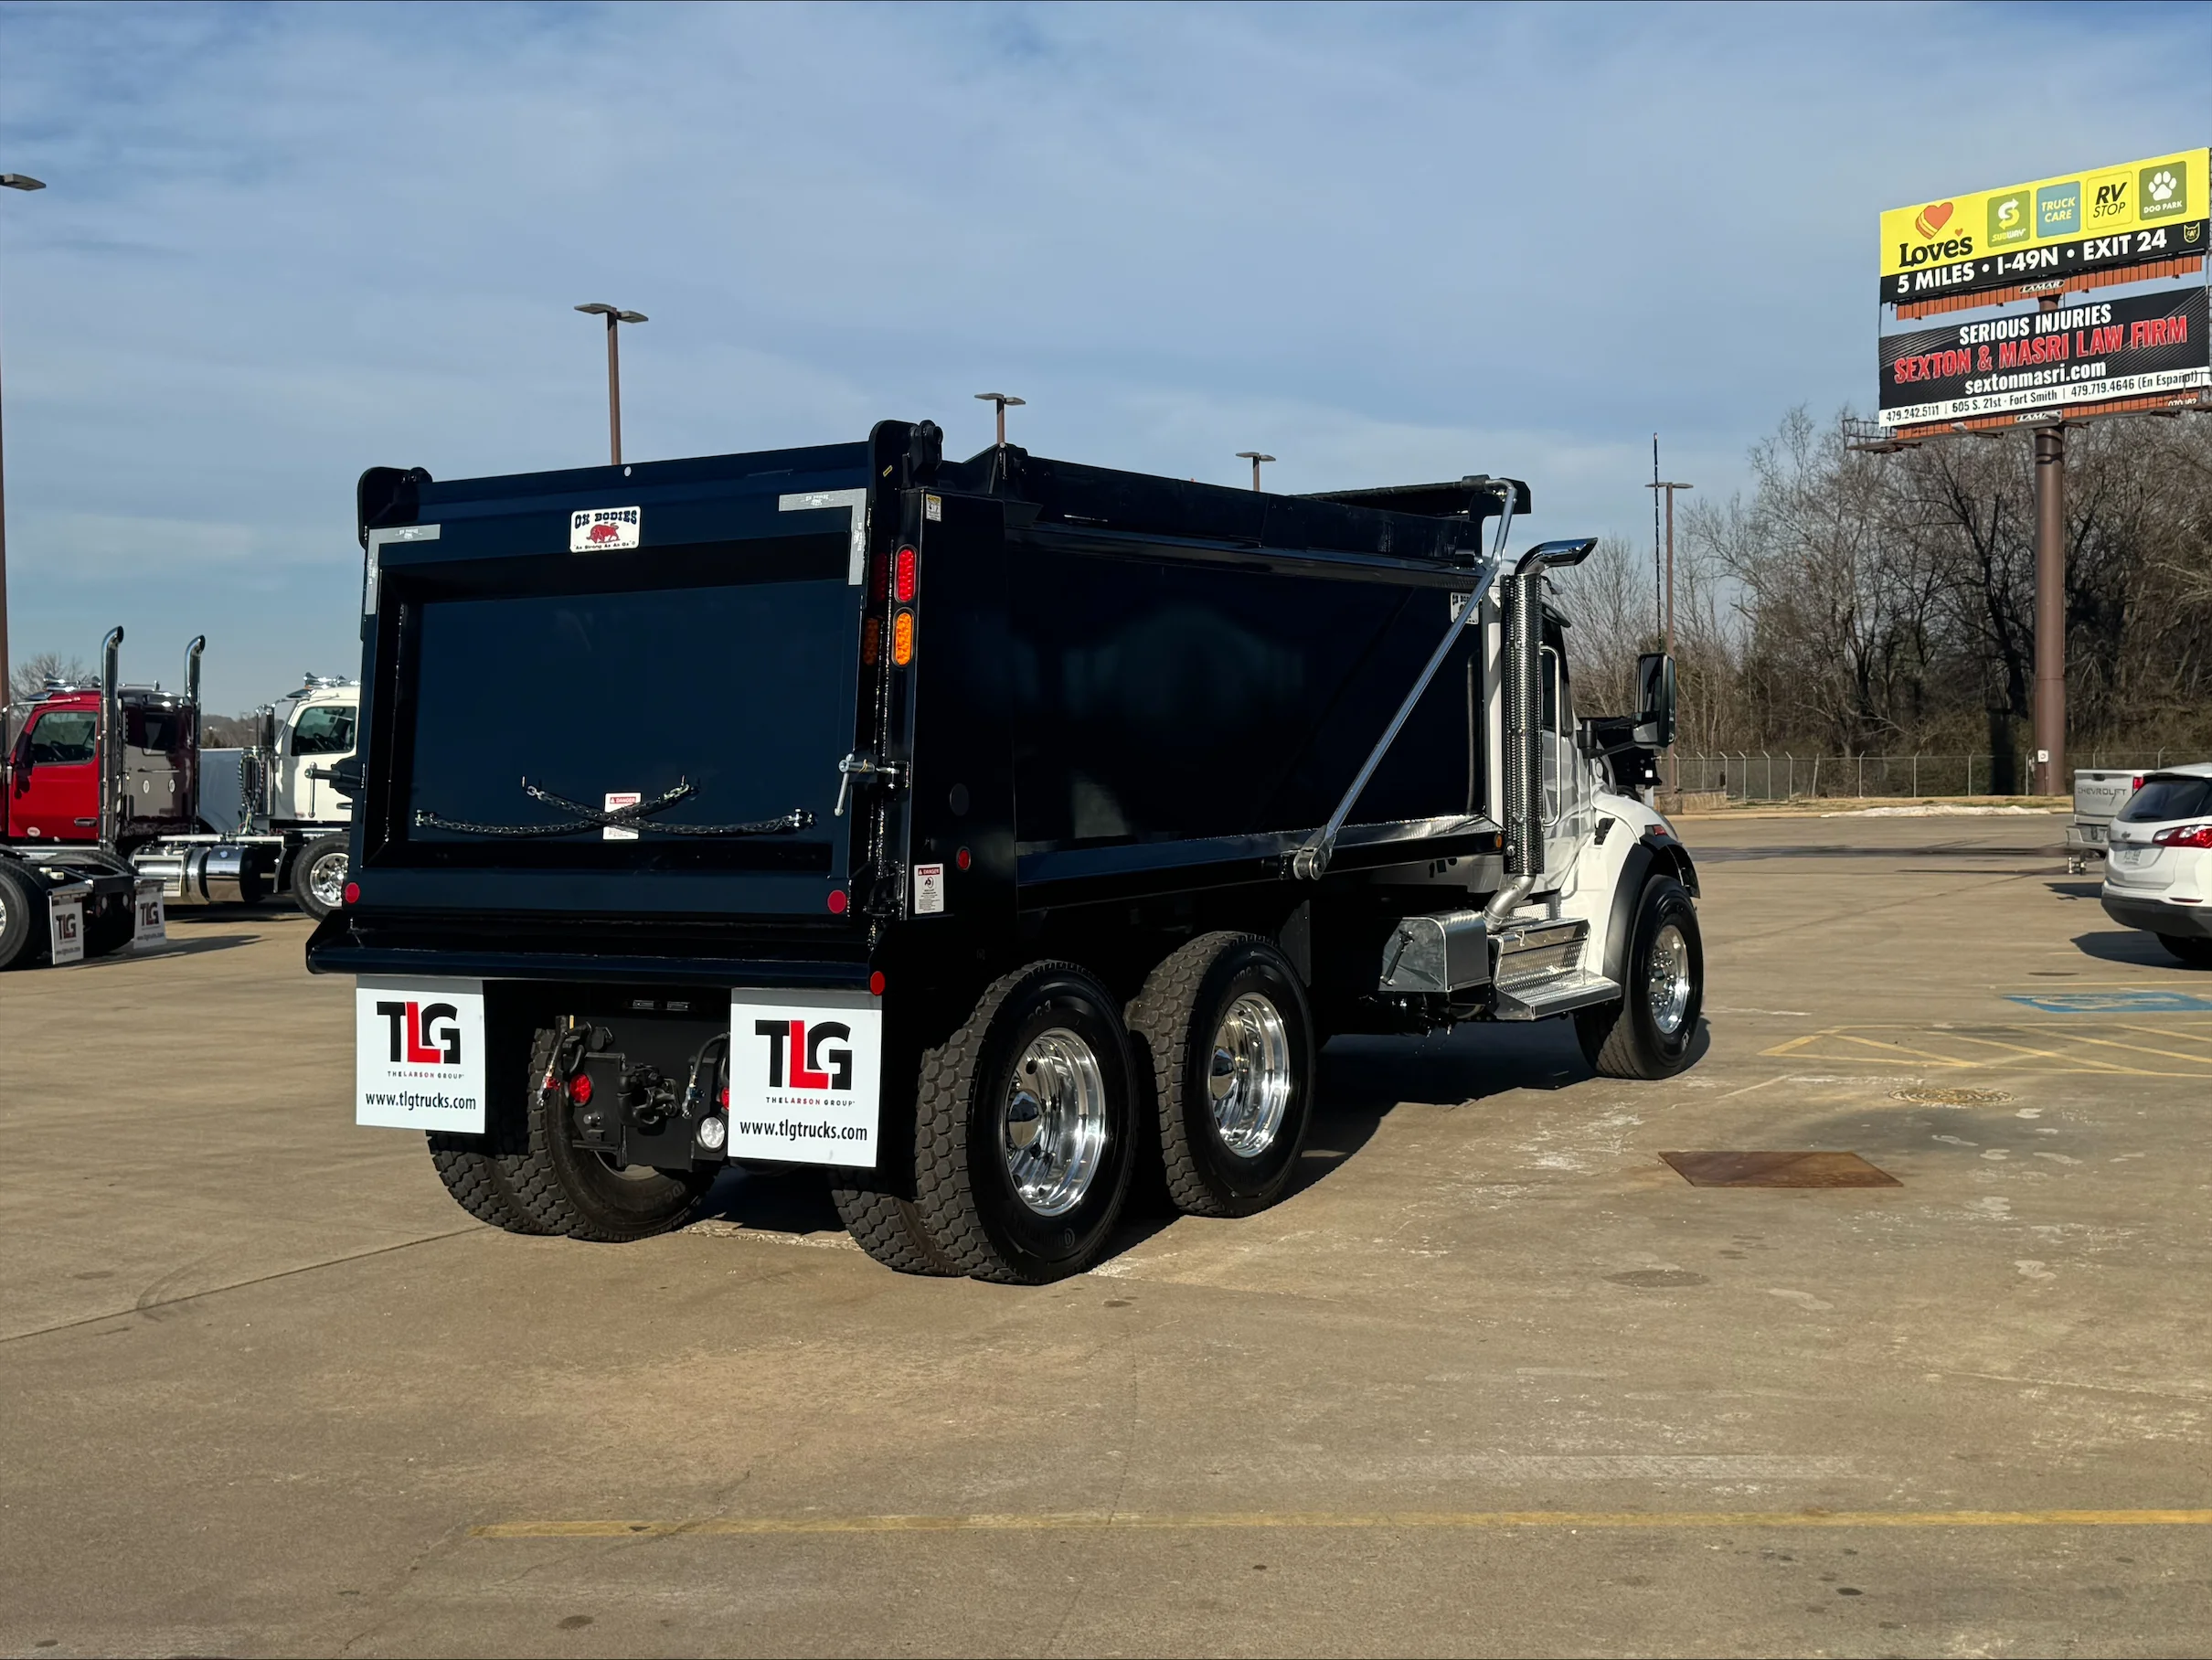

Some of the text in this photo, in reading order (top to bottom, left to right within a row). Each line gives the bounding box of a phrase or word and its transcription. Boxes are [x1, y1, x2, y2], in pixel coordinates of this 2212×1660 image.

[2041, 196, 2076, 212] TRUCK
[2095, 182, 2128, 206] RV
[2044, 209, 2072, 223] CARE
[2093, 201, 2126, 218] STOP
[2143, 200, 2183, 214] DOG PARK
[1992, 229, 2026, 242] SUBWAY
[1897, 229, 2167, 293] 5 MILES I-49N EXIT 24
[2020, 280, 2064, 293] LAMAR
[1959, 303, 2111, 346] SERIOUS INJURIES
[1894, 315, 2187, 384] SEXTON & MASRI LAW FIRM
[1965, 361, 2106, 395] sextonmasri.com
[1952, 399, 1969, 413] 605
[1973, 398, 1981, 410] S.
[1983, 397, 2002, 409] 21st
[2009, 393, 2027, 406] Fort
[2030, 389, 2057, 402] Smith
[2071, 378, 2135, 398] 479.719.4646
[2138, 377, 2153, 389] (En
[575, 510, 637, 529] OX BODIES
[140, 901, 160, 926] TLG
[56, 913, 76, 940] TLG
[377, 1001, 461, 1064] TLG
[755, 1019, 853, 1091] TLG
[366, 1091, 476, 1111] www.tlgtrucks.com
[824, 1098, 854, 1107] GROUP
[739, 1119, 867, 1142] www.tlgtrucks.com
